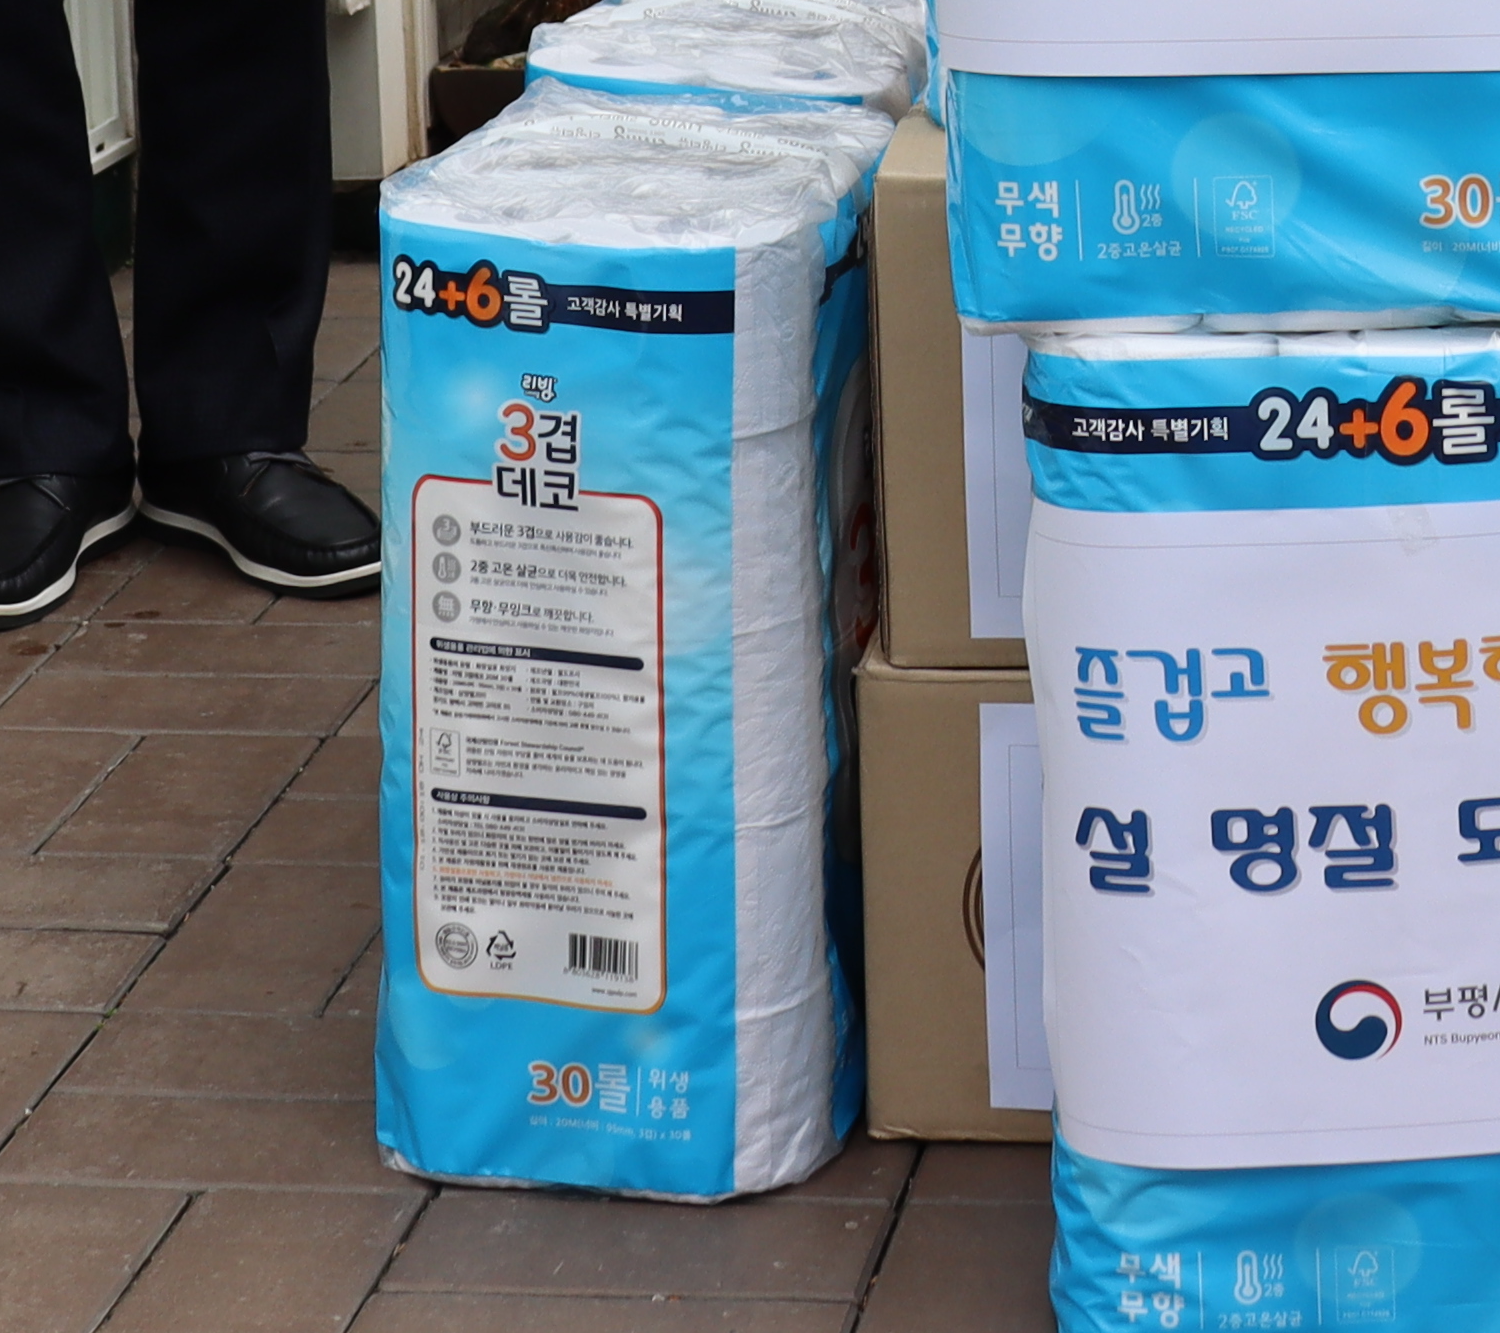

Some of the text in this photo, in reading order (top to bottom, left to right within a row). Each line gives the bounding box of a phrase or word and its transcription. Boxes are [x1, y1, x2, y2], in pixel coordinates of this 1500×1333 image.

[995, 181, 1060, 218] 무색
[997, 222, 1063, 261] 무향
[1097, 240, 1182, 259] 2중고온살균
[567, 296, 620, 318] 고객감사
[624, 301, 683, 322] 특별기획
[500, 403, 577, 464] 3겹
[1072, 417, 1145, 441] 고객감사
[1150, 416, 1229, 441] 특별기획
[496, 466, 578, 512] 데코
[470, 521, 514, 536] 부드러운
[1074, 645, 1270, 741] 즐겁고
[1075, 807, 1154, 896] 설
[1211, 803, 1400, 893] 명절
[1424, 1035, 1448, 1046] NTS
[527, 1060, 631, 1115] 30롤
[649, 1068, 689, 1093] 위생
[648, 1096, 689, 1120] 용품
[1117, 1251, 1181, 1289] 무색
[1117, 1291, 1185, 1328] 무향
